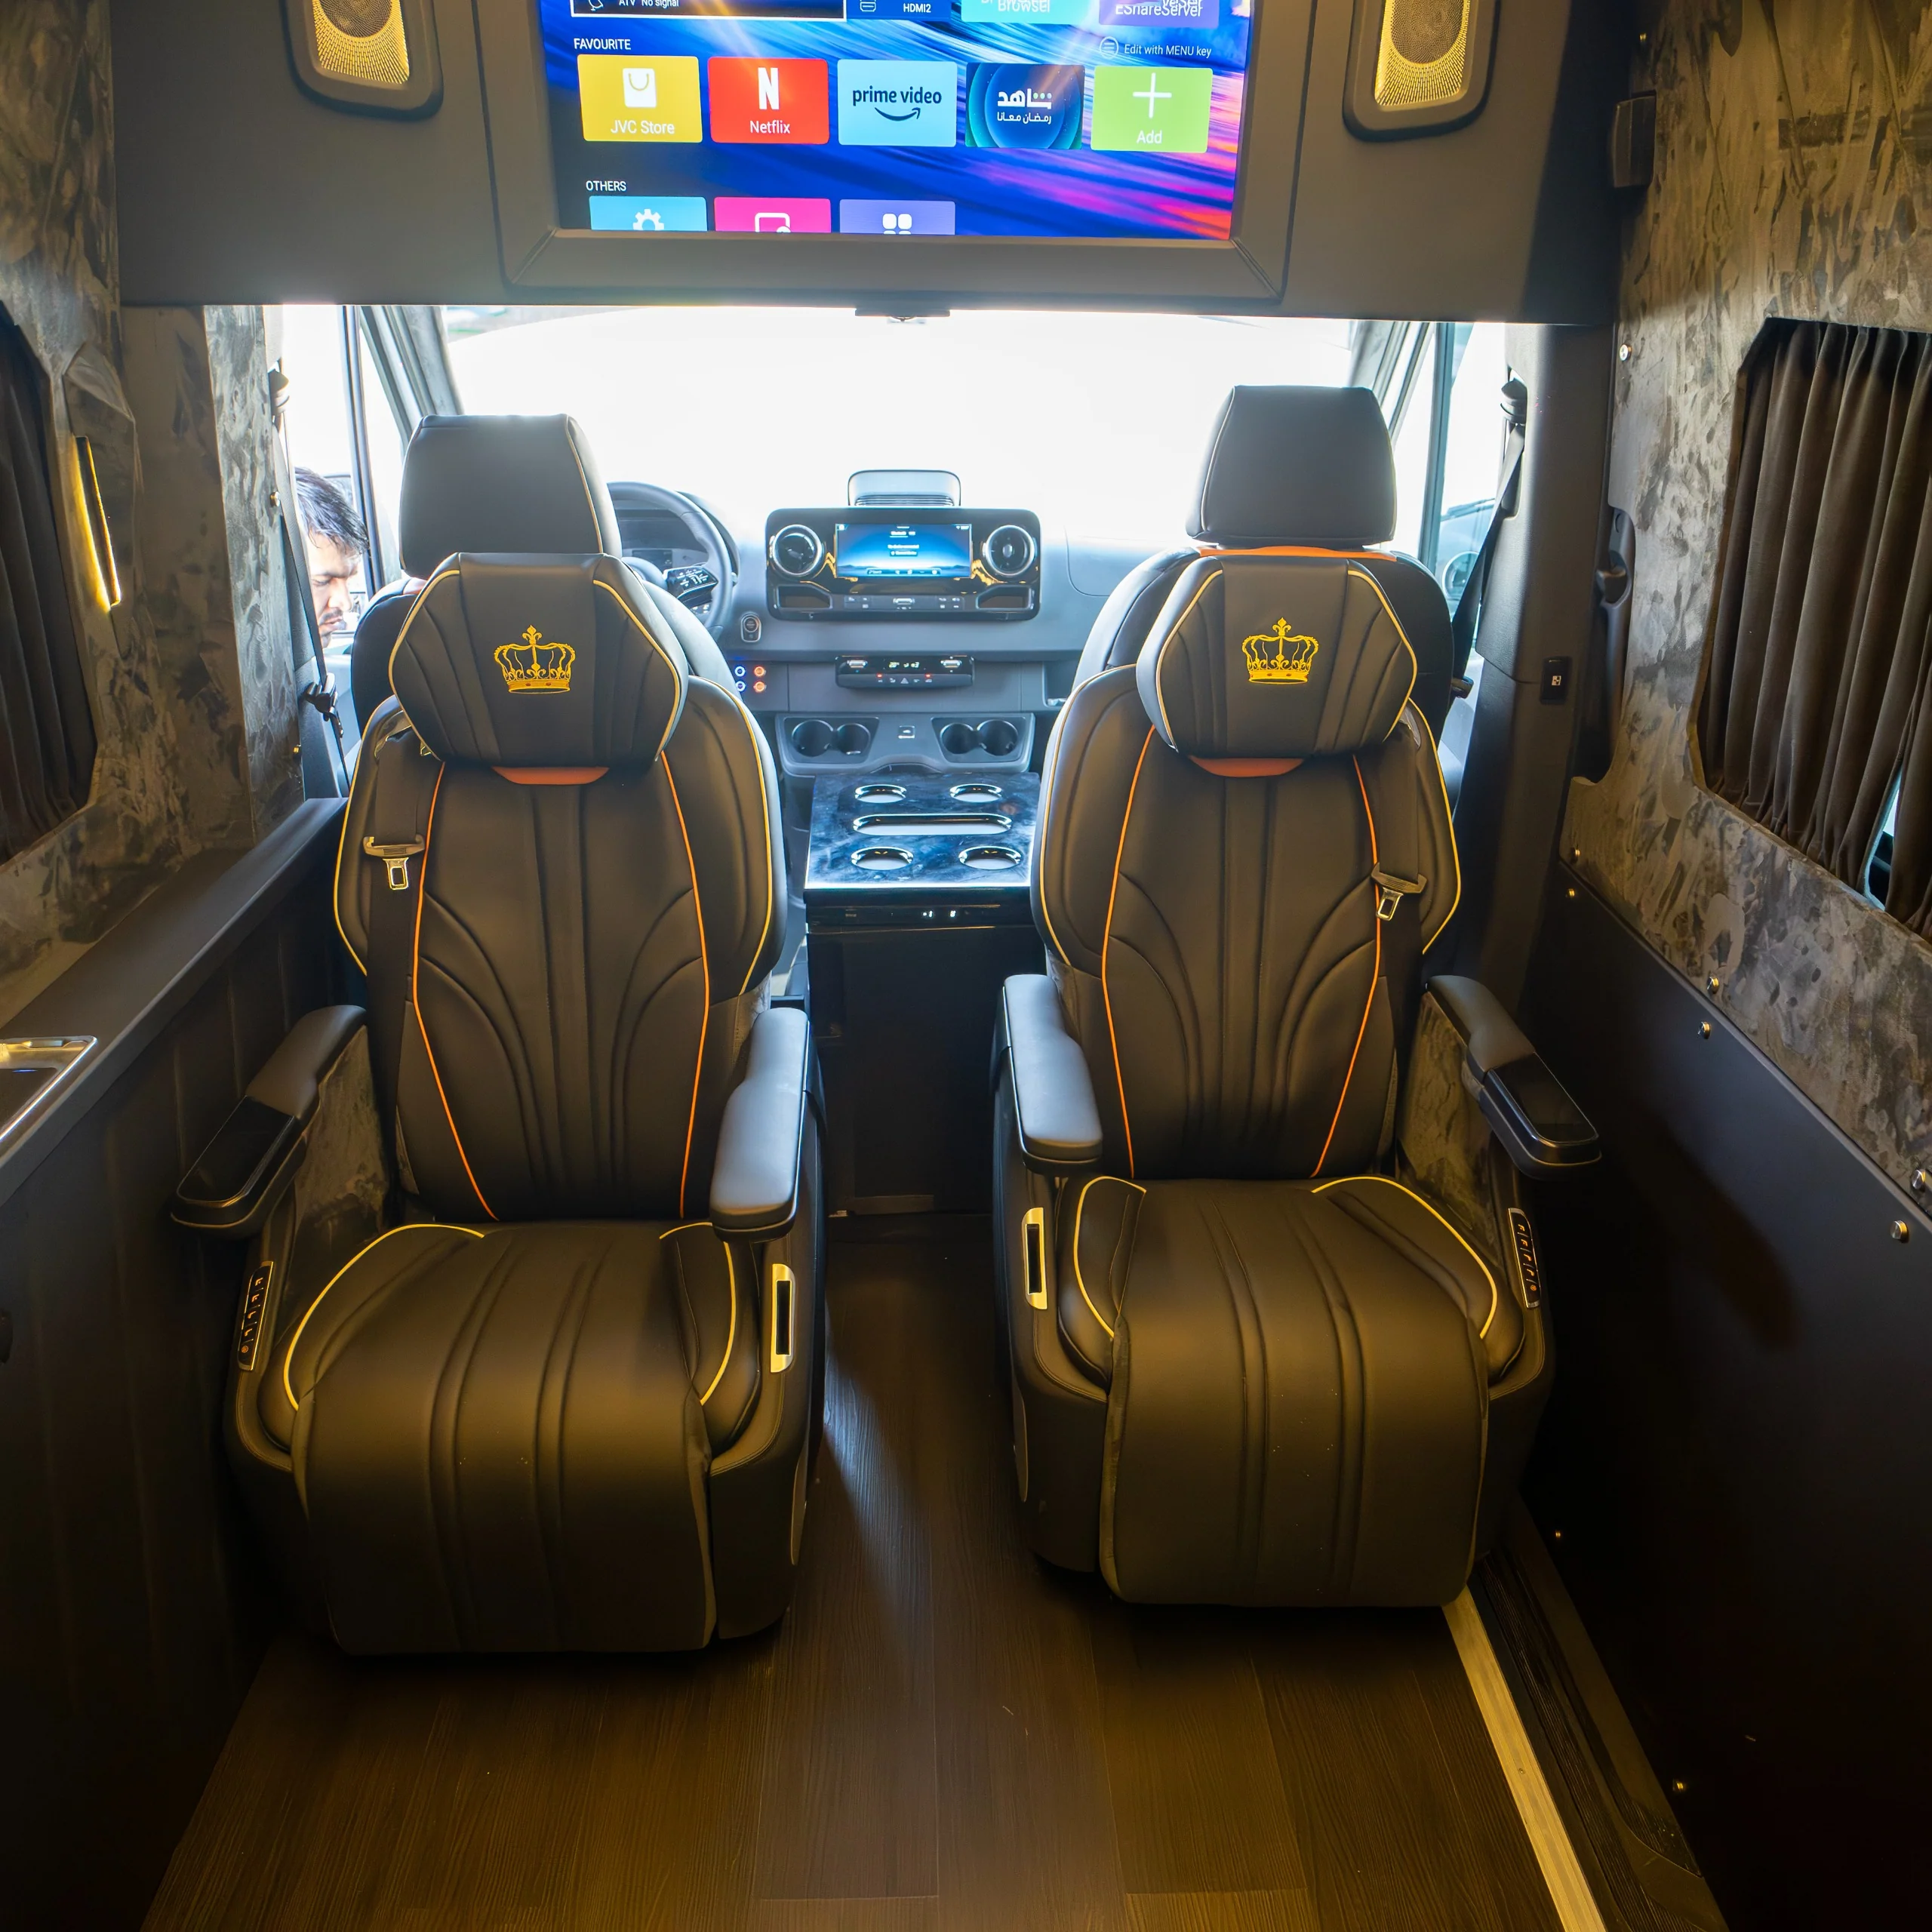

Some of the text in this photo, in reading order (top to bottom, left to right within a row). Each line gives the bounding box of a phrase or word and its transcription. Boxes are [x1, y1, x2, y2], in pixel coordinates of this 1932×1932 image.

[655, 0, 679, 8] signal
[903, 3, 931, 13] HDMI2
[574, 38, 631, 51] FAVOURITE
[1124, 44, 1212, 58] Edit with MENU key
[853, 85, 942, 106] prime video
[997, 88, 1052, 109] شاهد
[997, 112, 1051, 125] رمضان معانا
[611, 121, 675, 135] JVC Store
[749, 120, 790, 134] Netflix
[1137, 130, 1162, 144] Add
[586, 180, 626, 192] OTHERS
